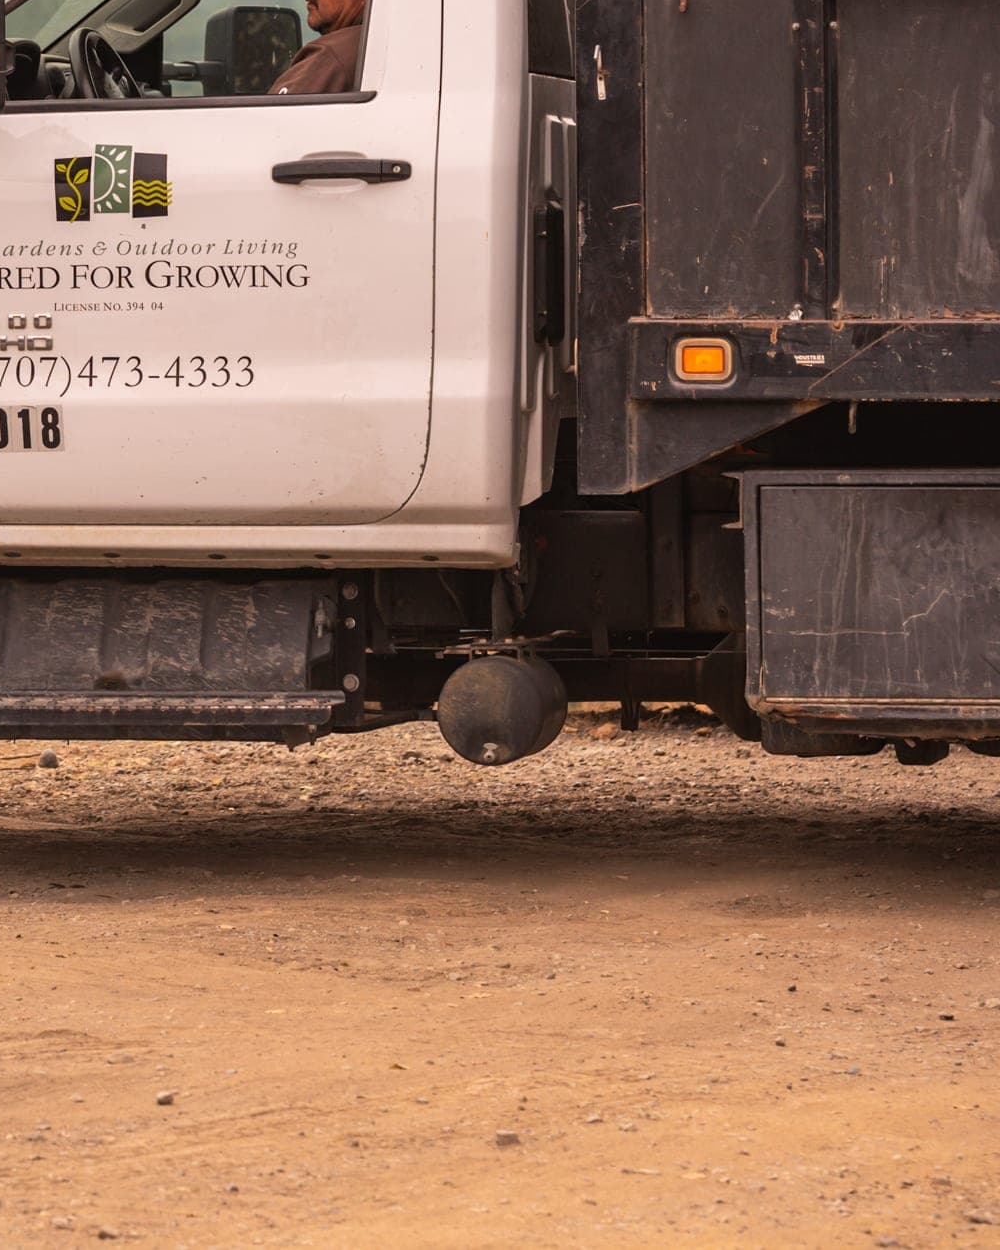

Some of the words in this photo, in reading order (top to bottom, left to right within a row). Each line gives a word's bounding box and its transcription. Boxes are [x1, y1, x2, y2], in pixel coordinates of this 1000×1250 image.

[91, 241, 108, 256] &
[116, 238, 216, 256] Outdoor
[223, 239, 298, 259] Living
[0, 335, 53, 352] HD
